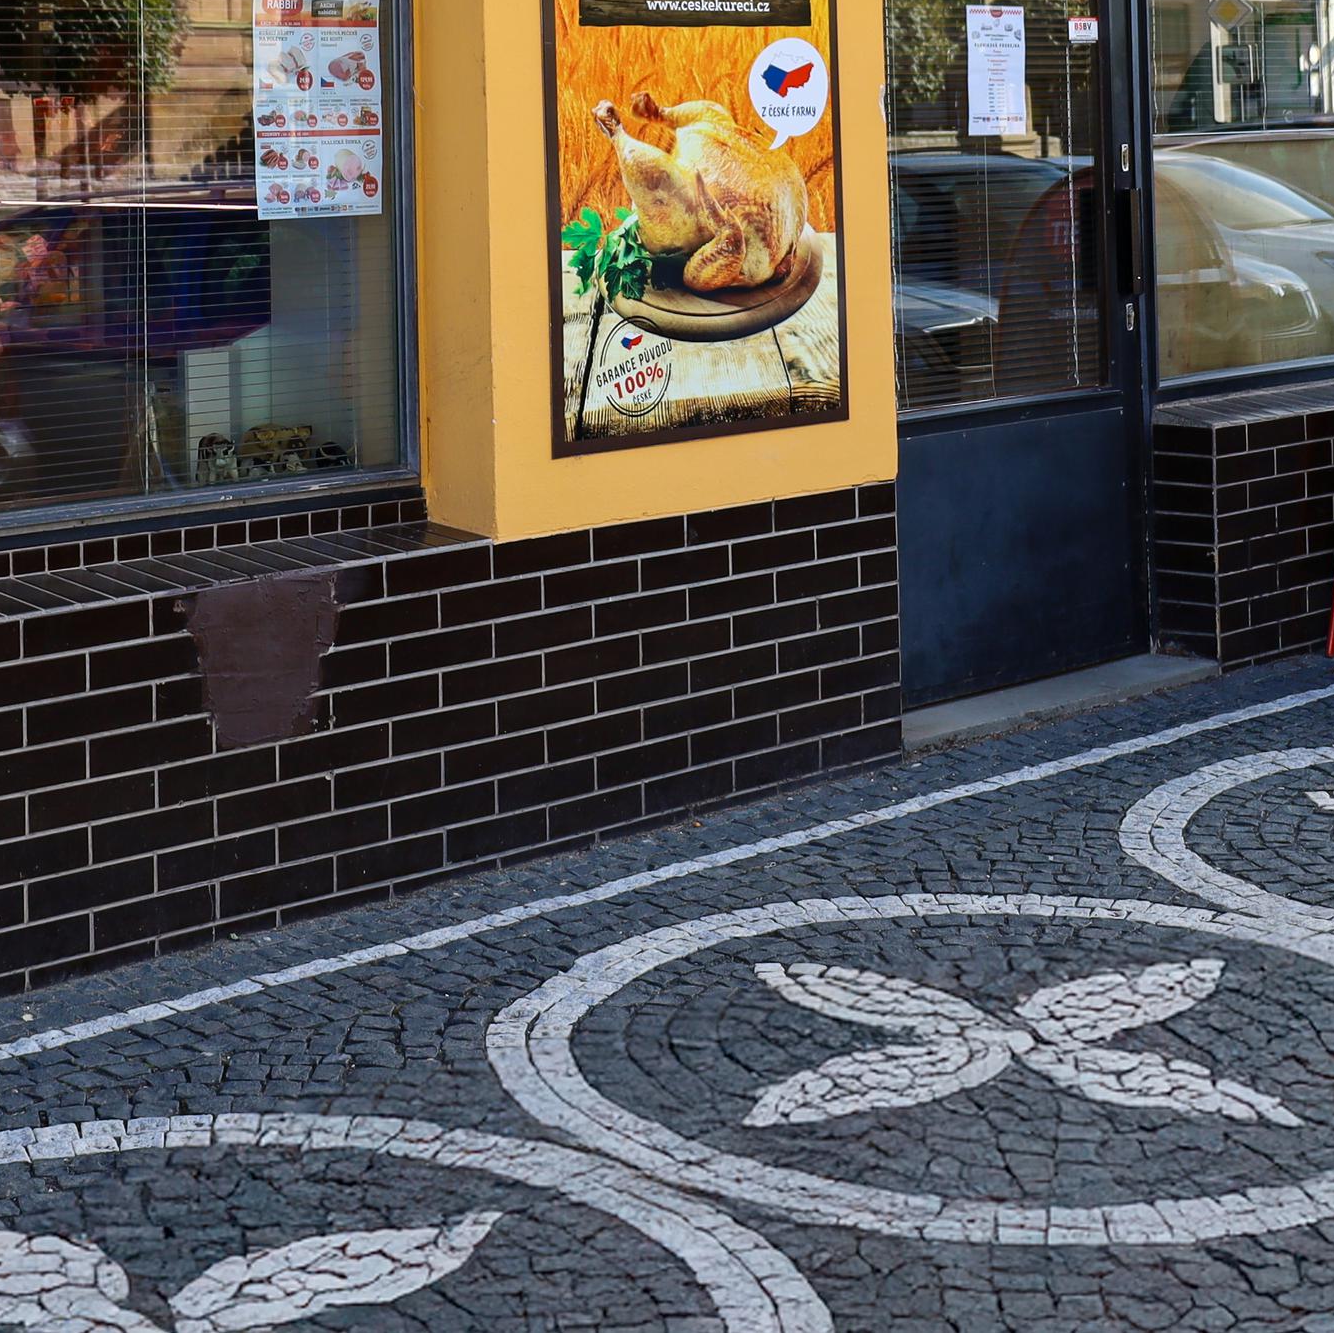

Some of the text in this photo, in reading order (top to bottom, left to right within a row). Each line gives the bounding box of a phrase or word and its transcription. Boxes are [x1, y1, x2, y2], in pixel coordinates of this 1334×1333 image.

[762, 104, 816, 117] Z ČESKÉ FARMY
[596, 339, 672, 387] GARANCE PŮVODU
[614, 362, 664, 399] 100%
[633, 388, 652, 405] ČESKÉ
